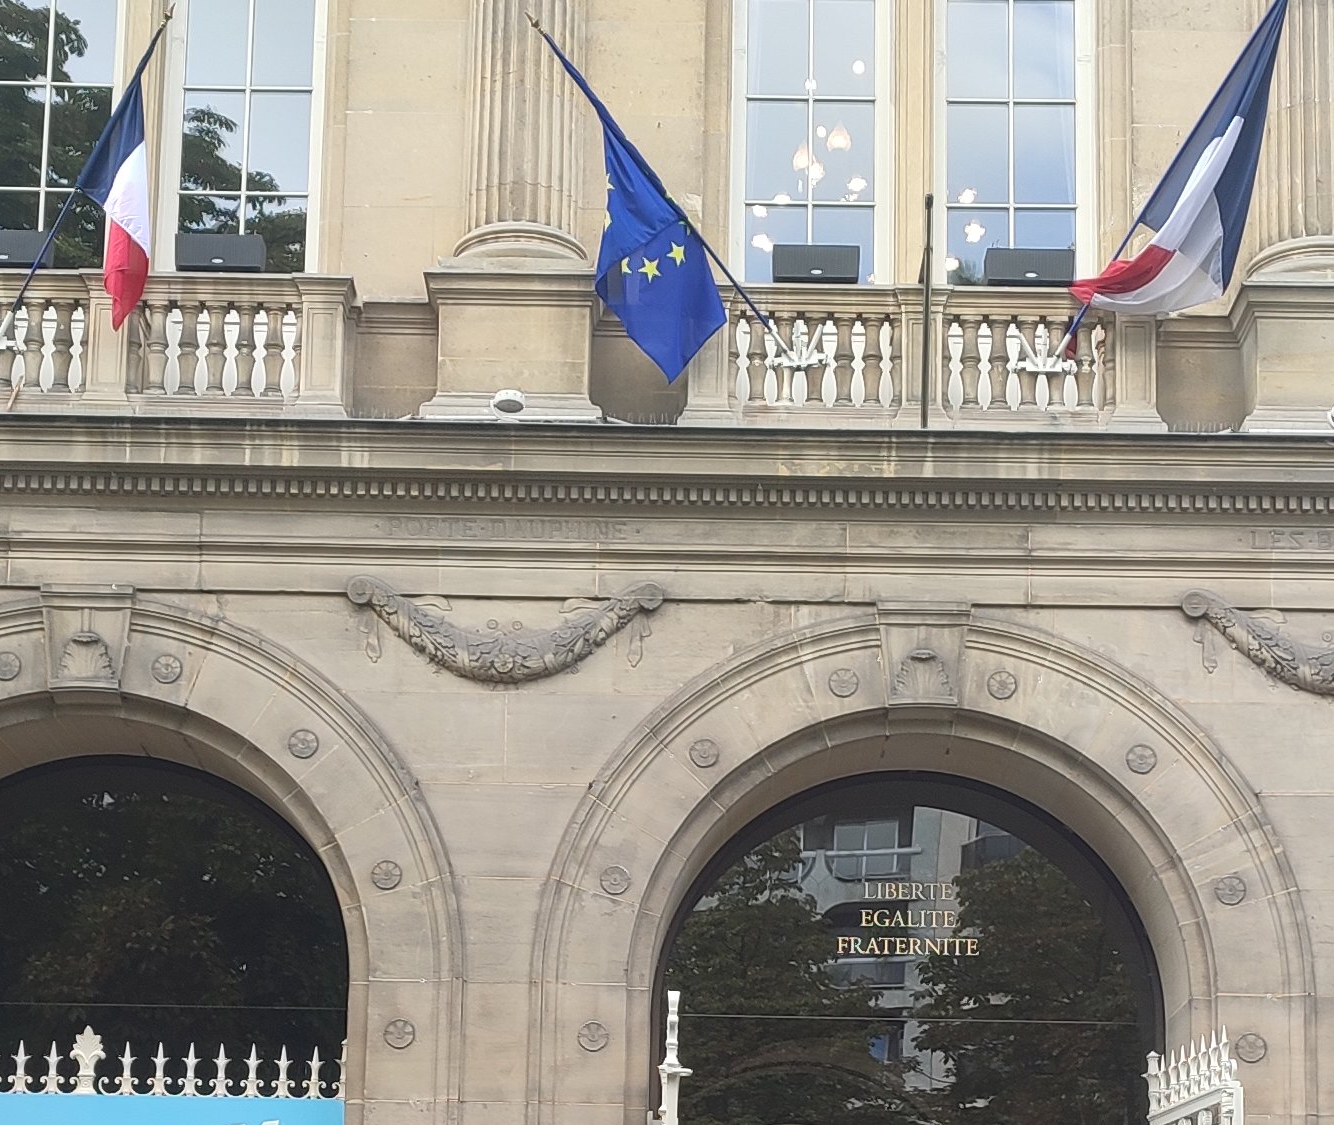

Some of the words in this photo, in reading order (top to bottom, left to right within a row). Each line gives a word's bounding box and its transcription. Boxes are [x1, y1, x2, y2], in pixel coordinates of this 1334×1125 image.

[383, 516, 476, 538] PORTE
[488, 518, 627, 541] DAUPHINE
[1250, 531, 1304, 550] LES
[863, 882, 954, 900] LIBERTE
[860, 909, 957, 928] EGALITE
[836, 936, 980, 956] FRATERNITE
